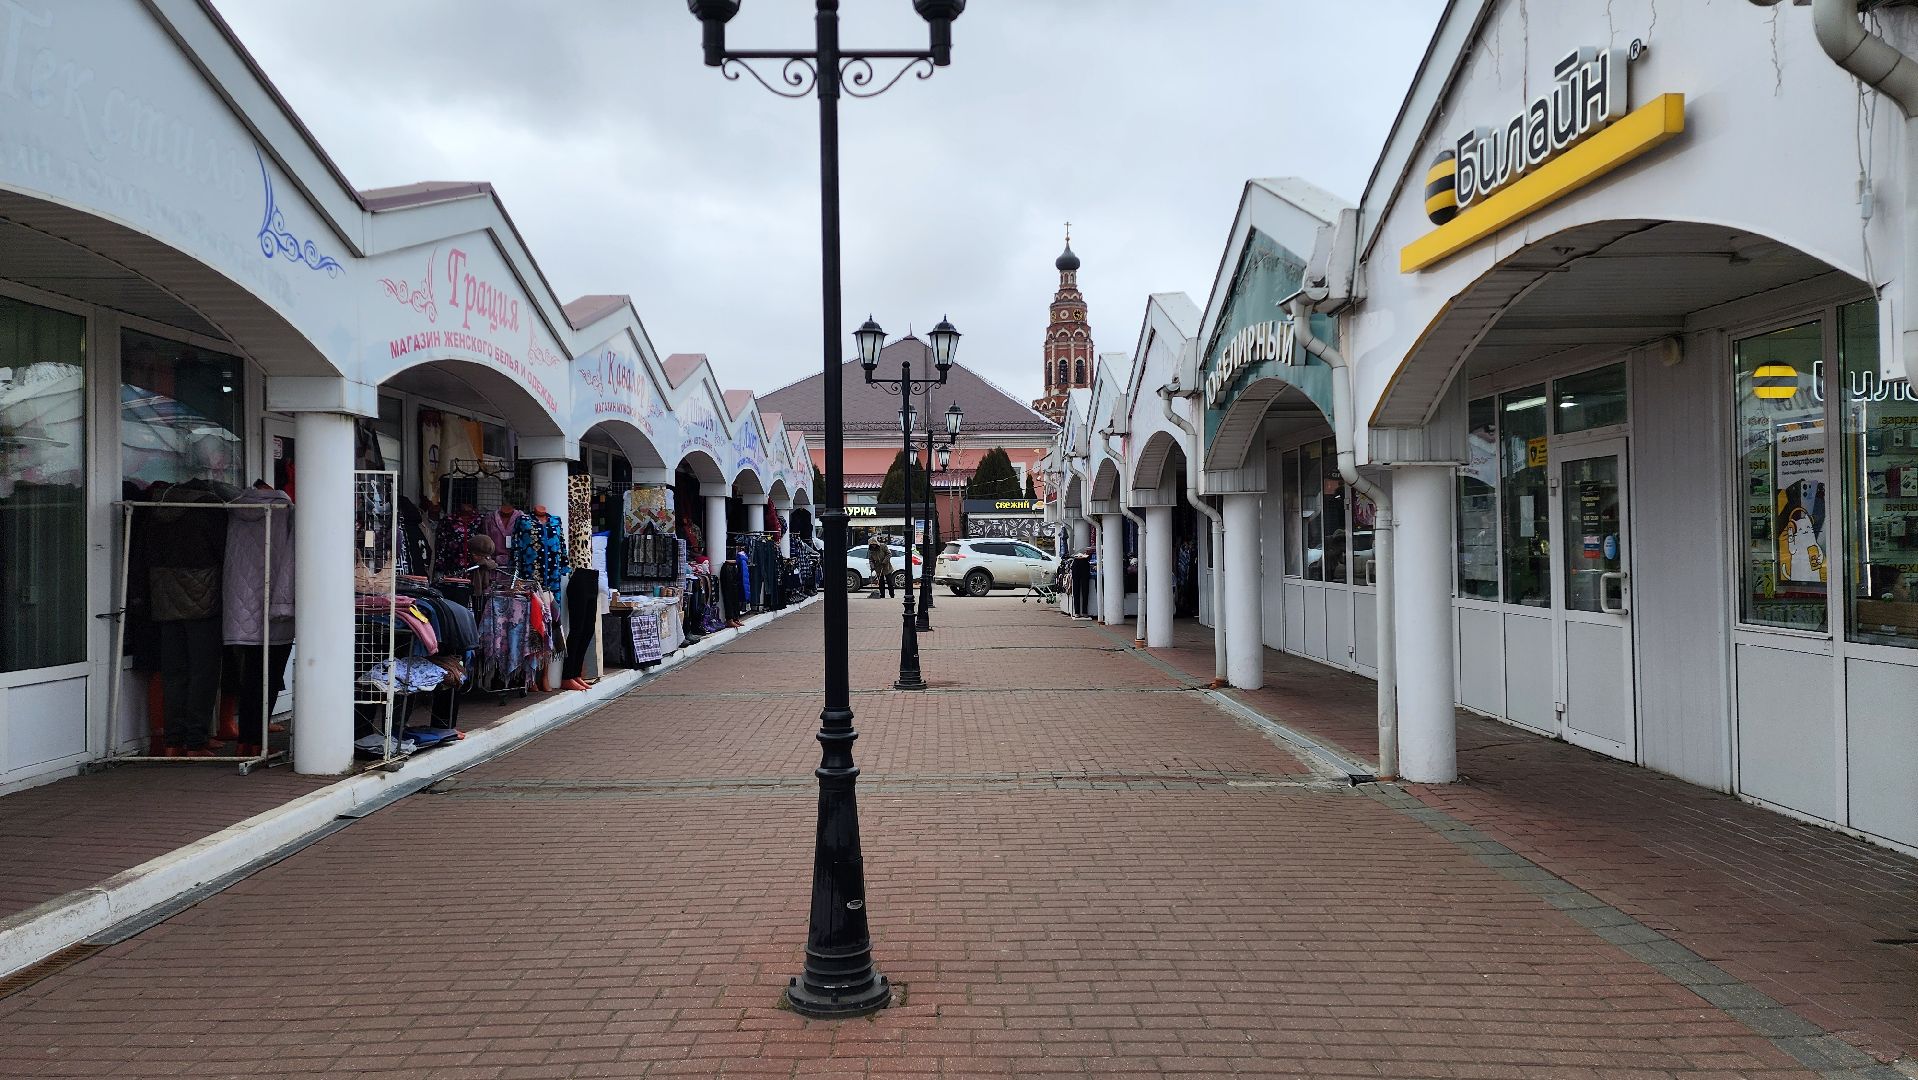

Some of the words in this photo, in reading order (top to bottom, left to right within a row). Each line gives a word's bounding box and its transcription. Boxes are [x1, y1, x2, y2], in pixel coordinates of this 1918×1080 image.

[446, 247, 520, 334] Грация
[390, 331, 441, 360] МАГАЗИН
[443, 330, 493, 357] ЖЕНСКОГО
[494, 347, 519, 374] БЕЛЬЯ
[520, 363, 527, 379] И
[527, 371, 559, 414] ОДЕЖДЫ
[607, 350, 646, 409] Кавалер
[1206, 314, 1296, 411] ЮВЕЛИРНЫЙ
